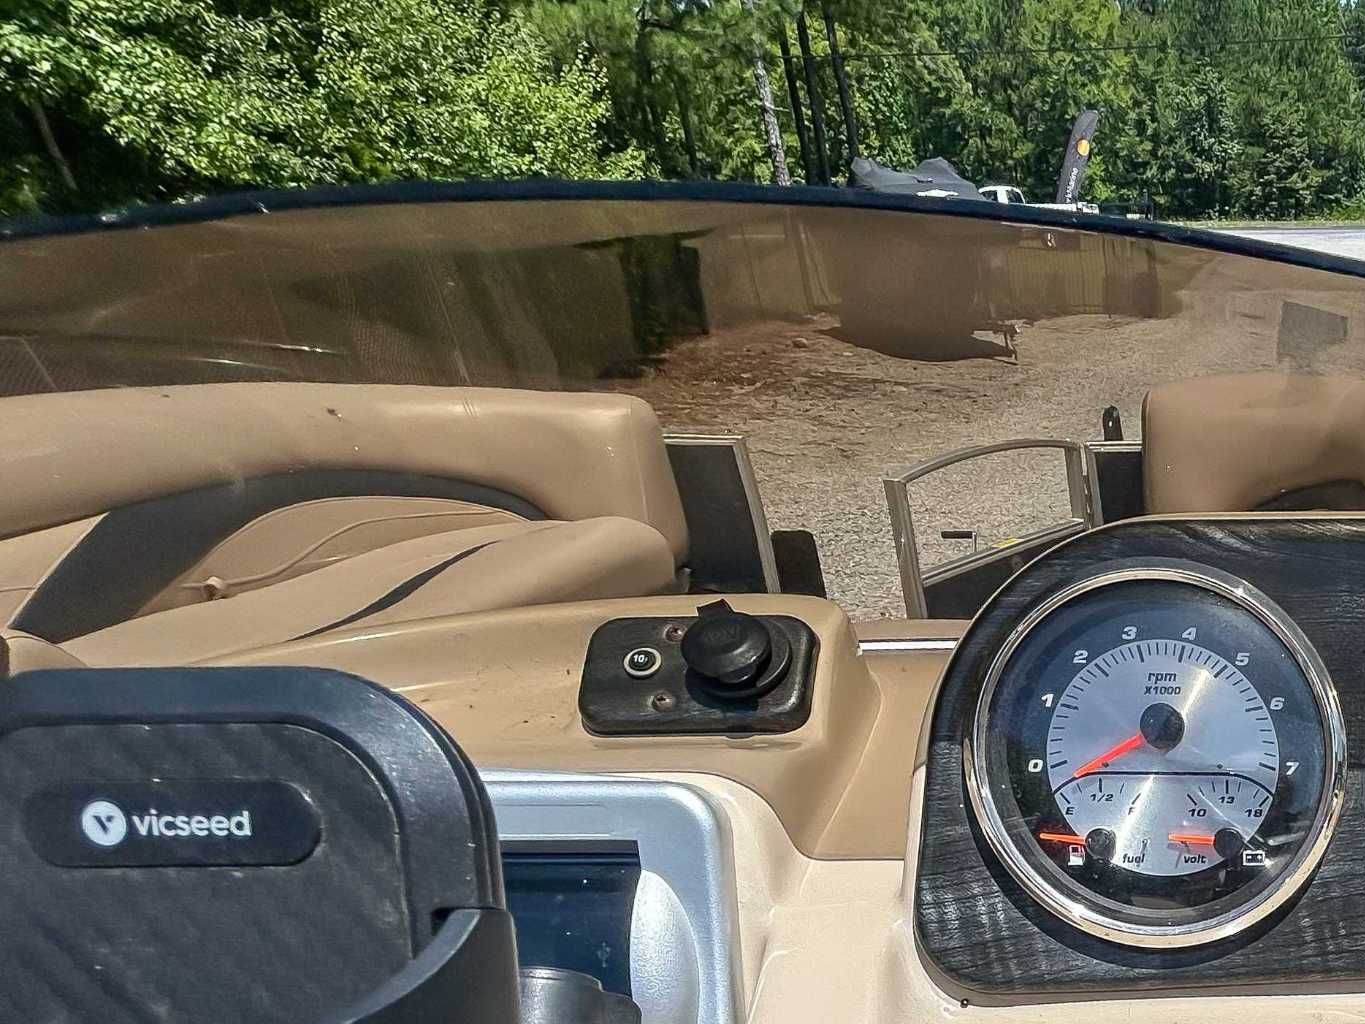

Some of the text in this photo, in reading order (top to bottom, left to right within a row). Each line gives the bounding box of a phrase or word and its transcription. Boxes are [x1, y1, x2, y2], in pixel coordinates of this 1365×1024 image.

[1122, 626, 1138, 640] 3
[1181, 627, 1197, 641] 4
[1073, 650, 1089, 664] 2
[1235, 652, 1250, 666] 5
[1147, 672, 1177, 685] rpm
[1144, 686, 1181, 696] X1000
[1041, 693, 1055, 708] 1
[1270, 697, 1285, 710] 6
[1028, 759, 1044, 773] 0
[1286, 761, 1300, 776] 7
[1089, 793, 1114, 803] 1/2
[1219, 796, 1236, 805] 13
[1065, 806, 1075, 816] E
[1127, 806, 1136, 816] F
[1187, 808, 1207, 818] 10
[1244, 809, 1263, 818] 18
[131, 808, 252, 837] vicseed
[1122, 853, 1146, 864] fuel
[1183, 854, 1207, 865] volt
